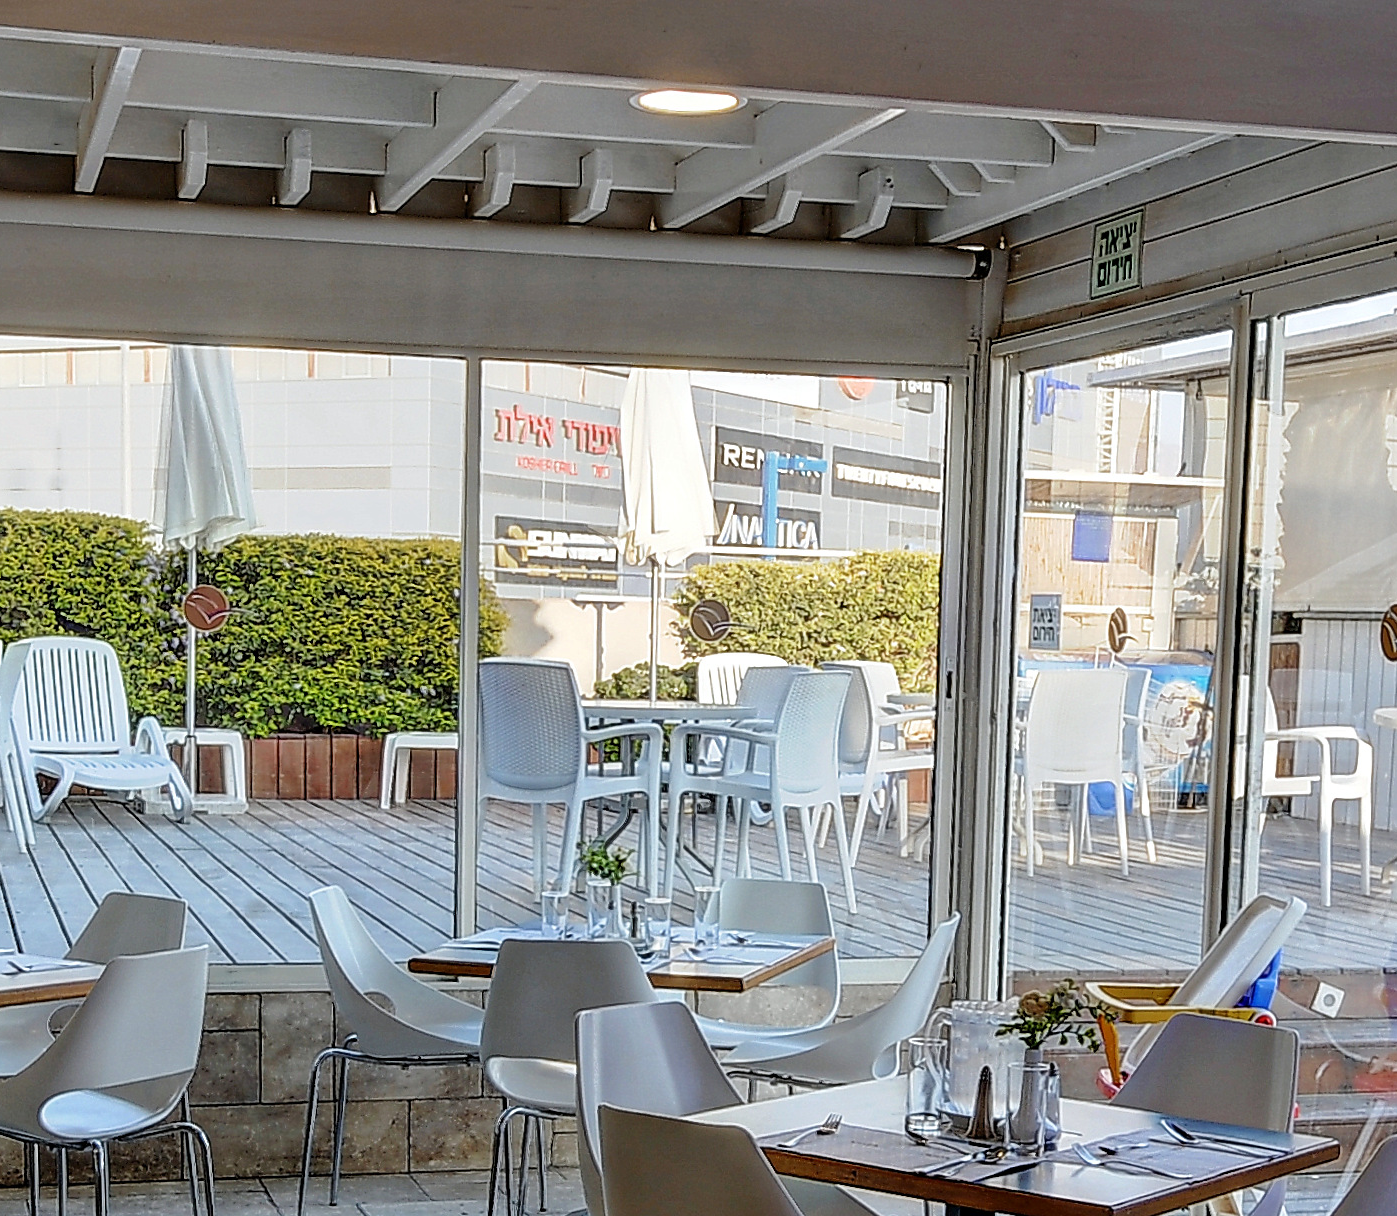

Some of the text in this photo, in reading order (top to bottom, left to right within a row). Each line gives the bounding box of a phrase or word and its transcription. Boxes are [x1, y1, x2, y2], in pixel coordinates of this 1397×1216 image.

[1097, 254, 1133, 287] חירום
[494, 404, 622, 458] יפודי אילת
[728, 513, 819, 550] NATICA
